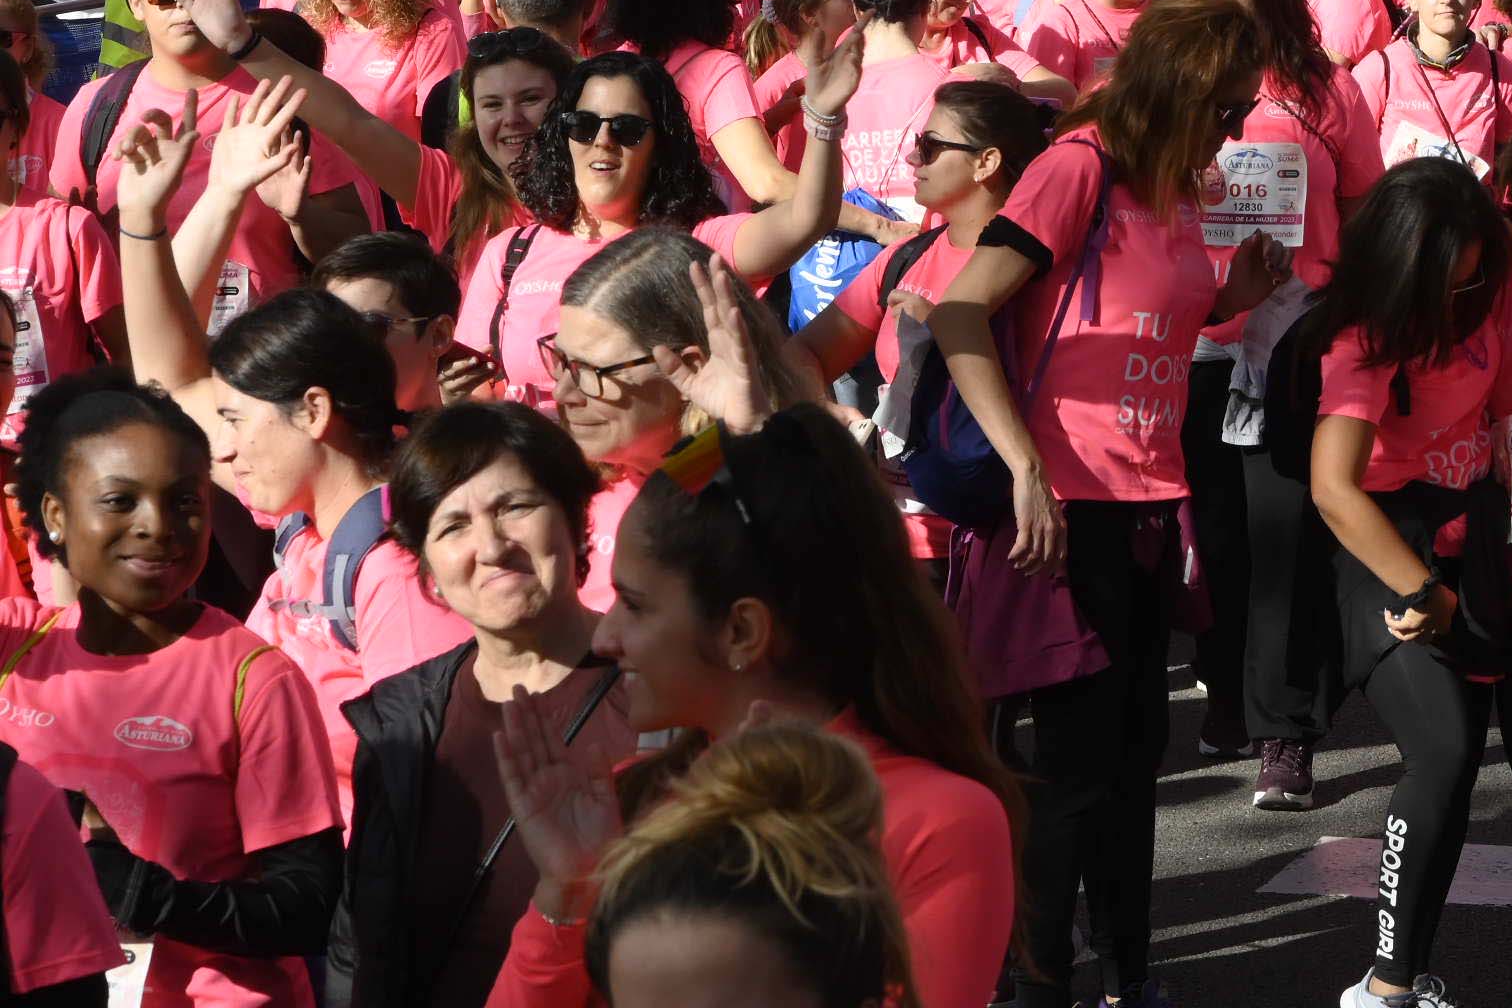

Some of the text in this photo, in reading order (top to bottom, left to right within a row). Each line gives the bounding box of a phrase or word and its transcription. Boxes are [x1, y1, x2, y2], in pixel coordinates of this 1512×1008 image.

[846, 129, 914, 148] ARRERA
[850, 149, 873, 168] DE
[1228, 159, 1270, 169] ASTURIANA
[1229, 183, 1268, 198] 016
[1233, 203, 1263, 212] 12830
[1132, 311, 1173, 342] TU
[120, 723, 185, 745] ASTURIANA
[1379, 814, 1408, 907] SPORT
